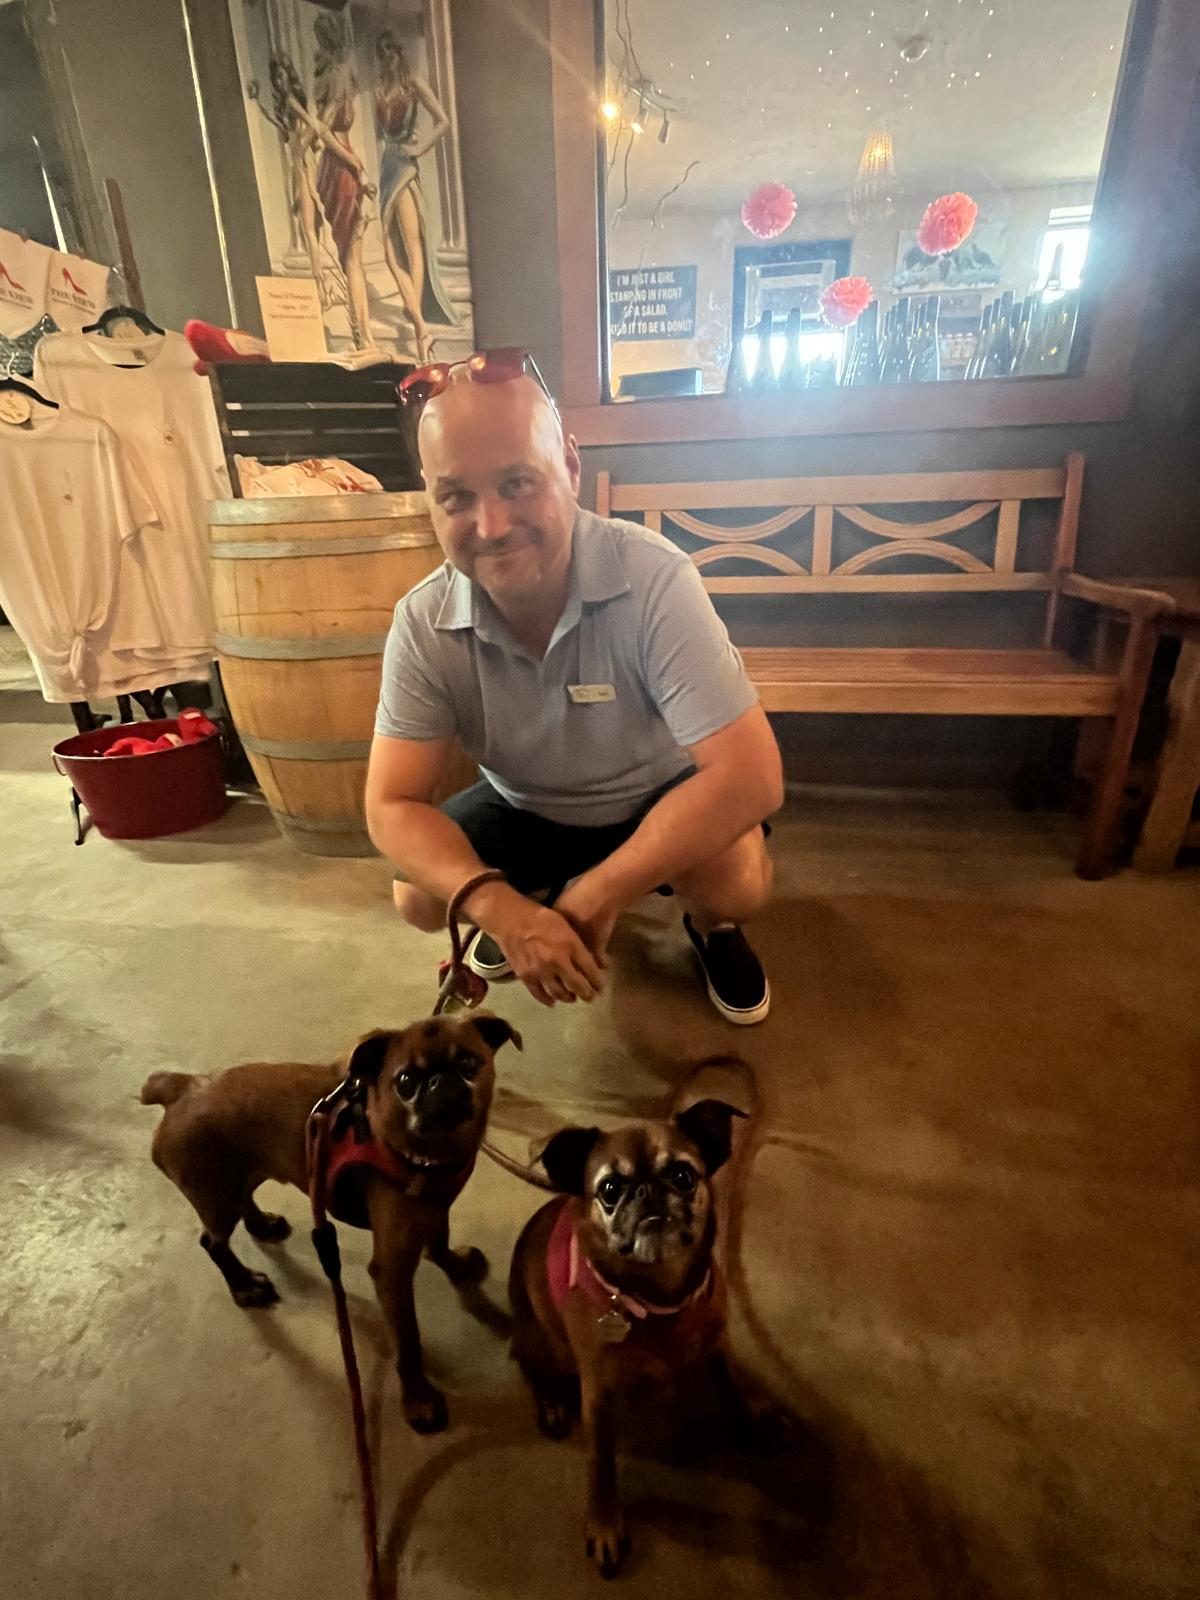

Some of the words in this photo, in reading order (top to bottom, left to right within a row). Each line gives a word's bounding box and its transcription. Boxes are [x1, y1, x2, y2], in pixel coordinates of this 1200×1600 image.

[631, 273, 648, 285] JUST
[650, 272, 656, 284] A
[657, 271, 674, 284] GIRL
[648, 288, 656, 301] IN
[658, 287, 682, 300] FRONT
[634, 305, 640, 317] A
[629, 322, 636, 334] IT
[638, 321, 647, 334] TO
[649, 321, 659, 333] BE
[660, 320, 666, 332] A
